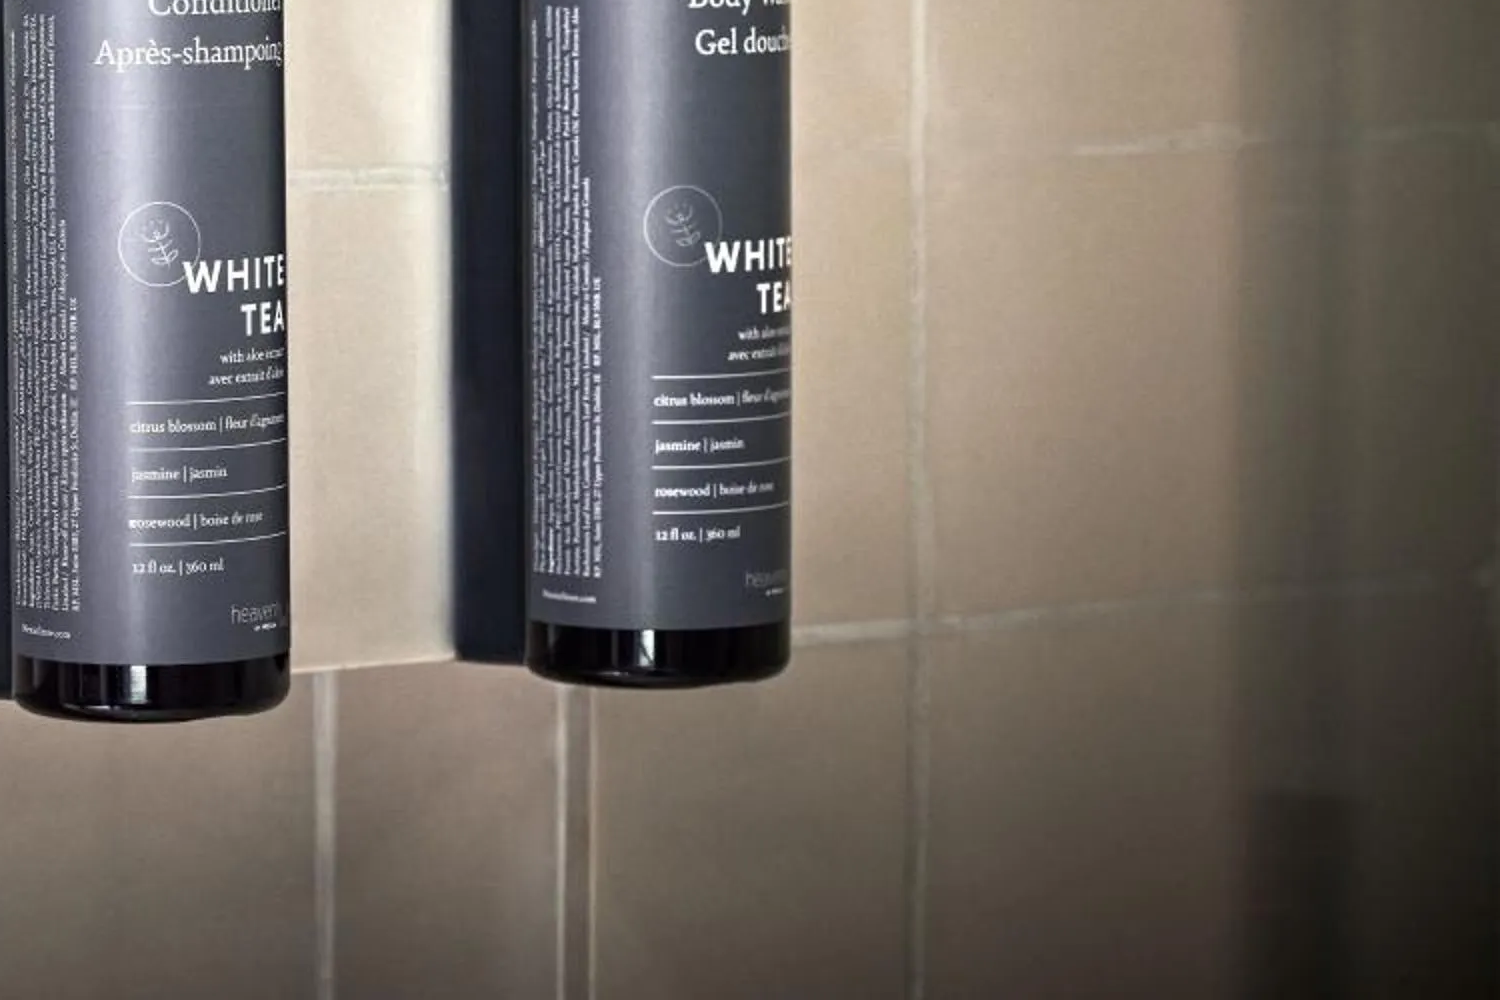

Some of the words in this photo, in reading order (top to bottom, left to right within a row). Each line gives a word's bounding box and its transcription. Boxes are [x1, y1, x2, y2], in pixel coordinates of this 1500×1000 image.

[695, 27, 738, 55] Gel
[94, 35, 282, 74] Après-shampoing
[705, 236, 791, 273] WHITE
[183, 253, 285, 294] WHITE
[756, 280, 791, 315] TEA
[240, 299, 285, 337] TEA
[219, 348, 245, 364] with
[208, 375, 233, 385] avec
[653, 393, 687, 407] citrus
[689, 391, 735, 406] blossom
[129, 419, 165, 434] citrus
[167, 417, 217, 433] blossom
[225, 415, 248, 430] fleur
[655, 439, 700, 455] jasmine
[710, 438, 745, 453] jasmin
[131, 466, 180, 482] jasmine
[189, 465, 227, 482] jasmin
[655, 482, 710, 498] rosewood
[128, 513, 191, 529] rosewood
[656, 530, 668, 541] 12
[131, 563, 146, 574] 12
[185, 560, 207, 576] 360
[209, 557, 225, 572] ml
